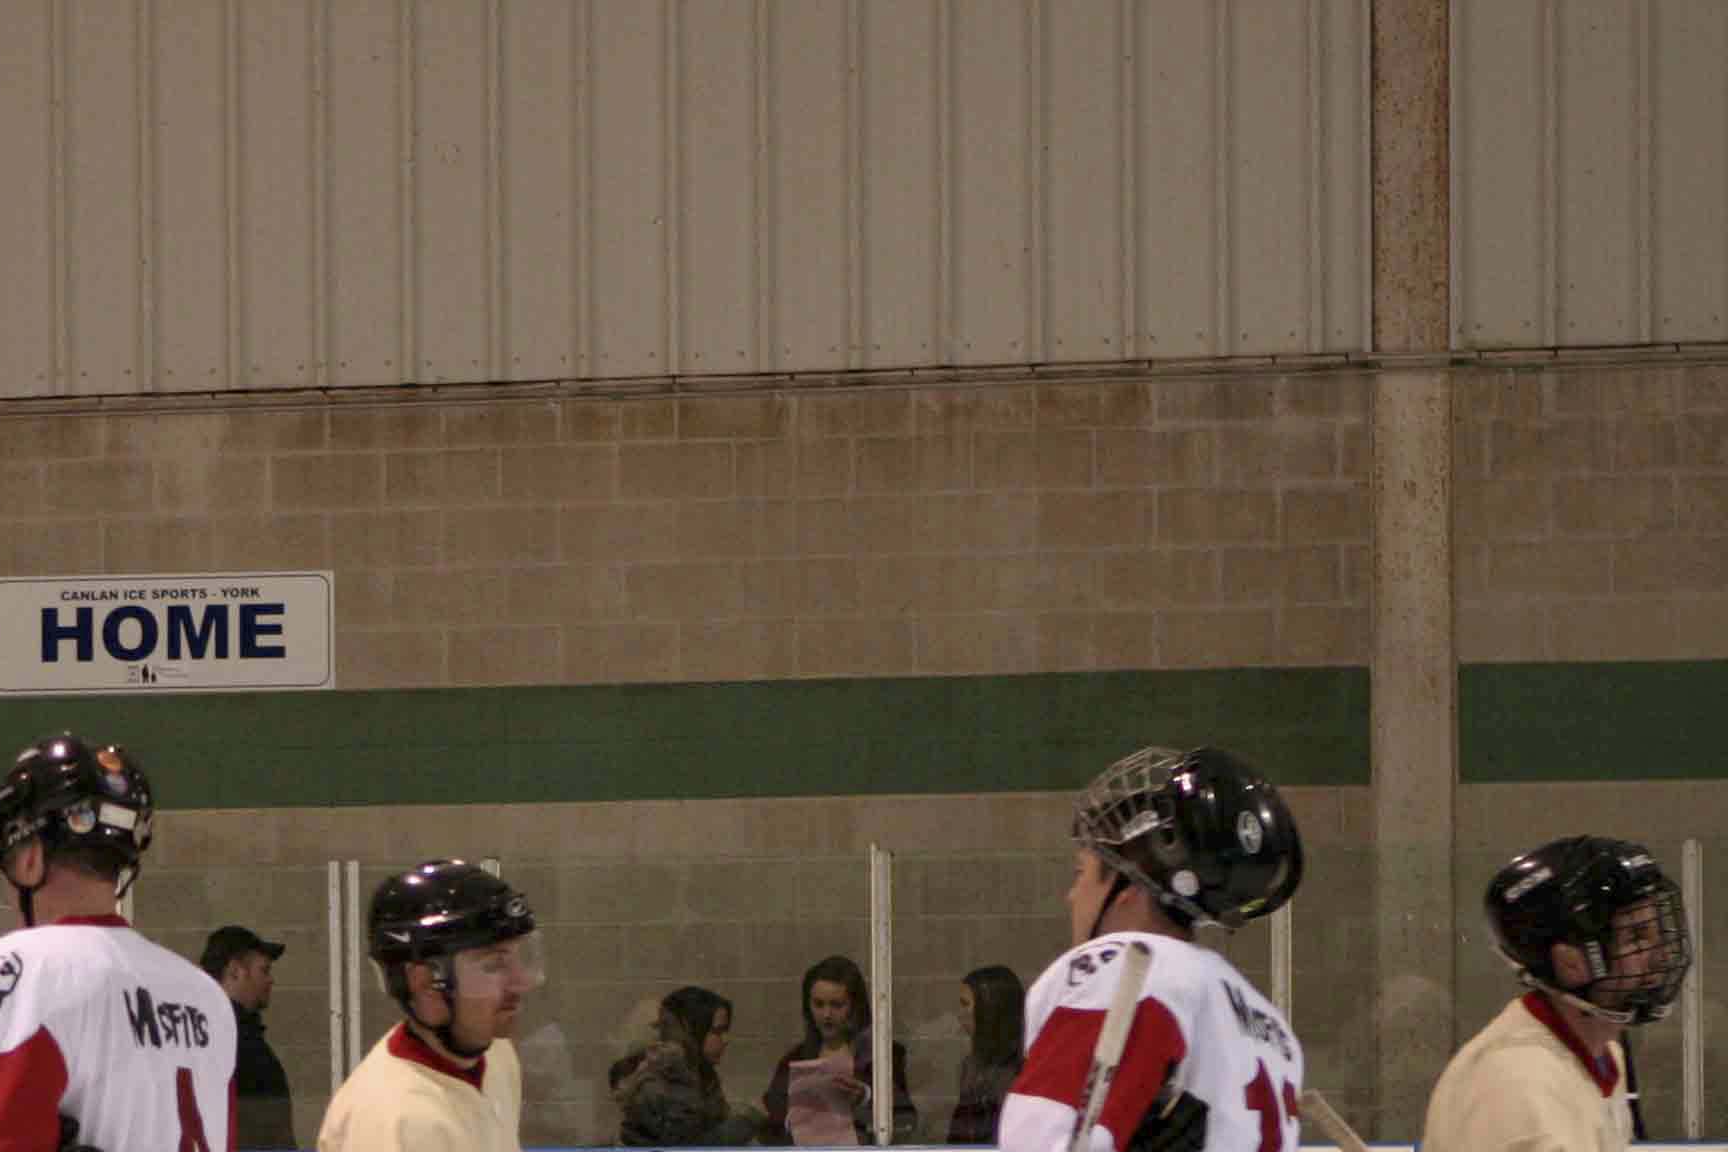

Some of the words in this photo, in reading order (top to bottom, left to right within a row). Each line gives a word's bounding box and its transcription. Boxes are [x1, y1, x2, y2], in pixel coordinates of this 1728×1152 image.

[61, 590, 119, 601] CANLAN
[124, 590, 146, 600] ICE
[152, 588, 208, 600] SPORTS
[221, 587, 260, 598] YORK
[41, 603, 286, 662] HOME
